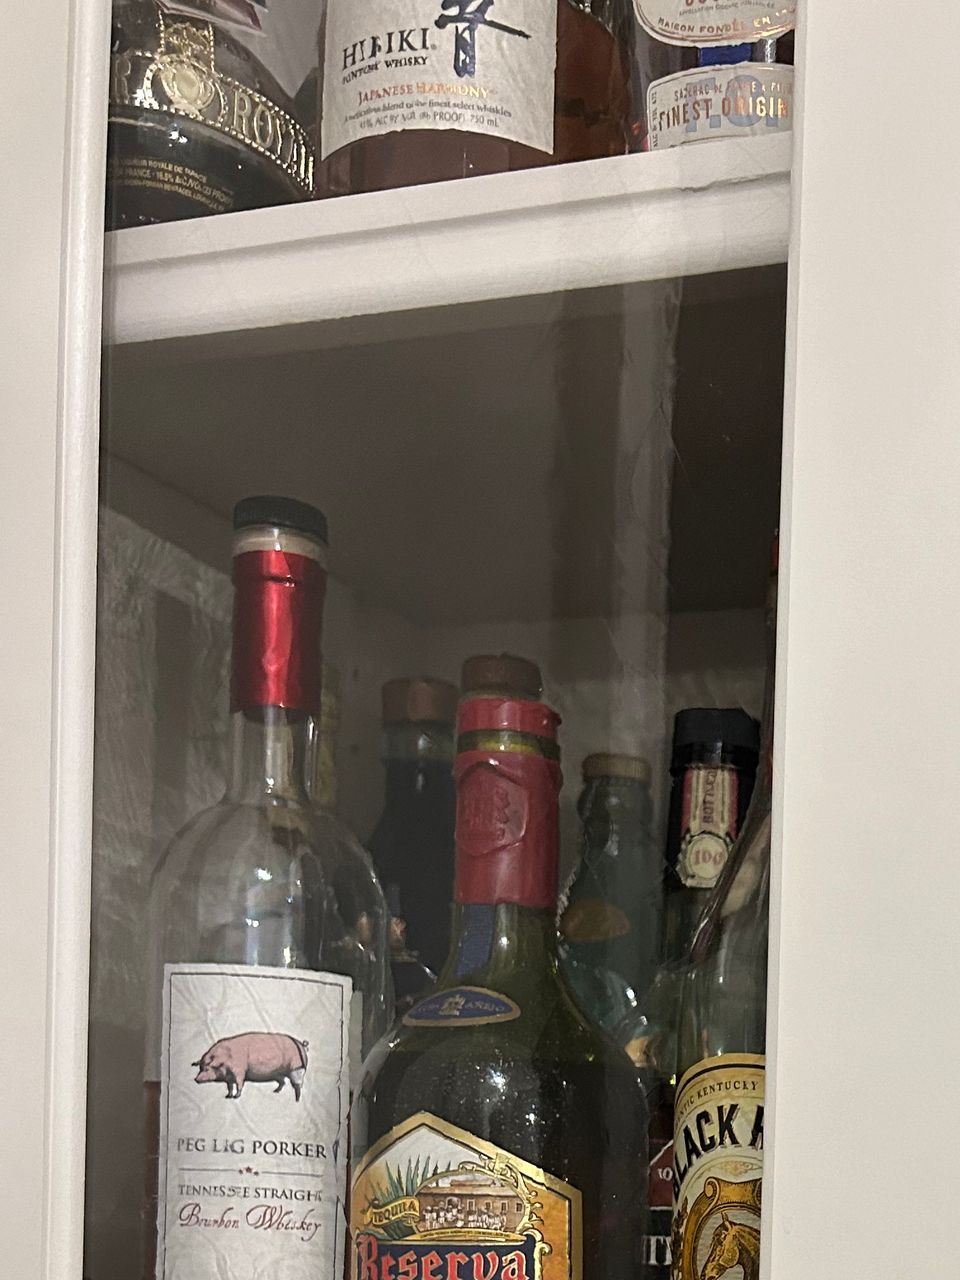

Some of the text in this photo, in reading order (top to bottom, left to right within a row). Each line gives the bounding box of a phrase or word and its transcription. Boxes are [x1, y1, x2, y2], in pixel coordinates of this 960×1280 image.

[658, 16, 695, 33] MAISON
[342, 28, 430, 71] HIBIKI
[385, 56, 429, 69] WHISKY
[358, 82, 489, 106] JAPANESE HARMONY
[674, 83, 710, 102] SAZERAC
[428, 100, 450, 109] finest
[453, 101, 475, 111] select
[659, 98, 712, 131] FINEST
[697, 1080, 758, 1099] KENTUCKY
[177, 1138, 206, 1153] PEG
[252, 1140, 327, 1160] PORKER
[254, 1187, 323, 1202] STRAIGHT
[372, 1201, 418, 1226] TEQUILA
